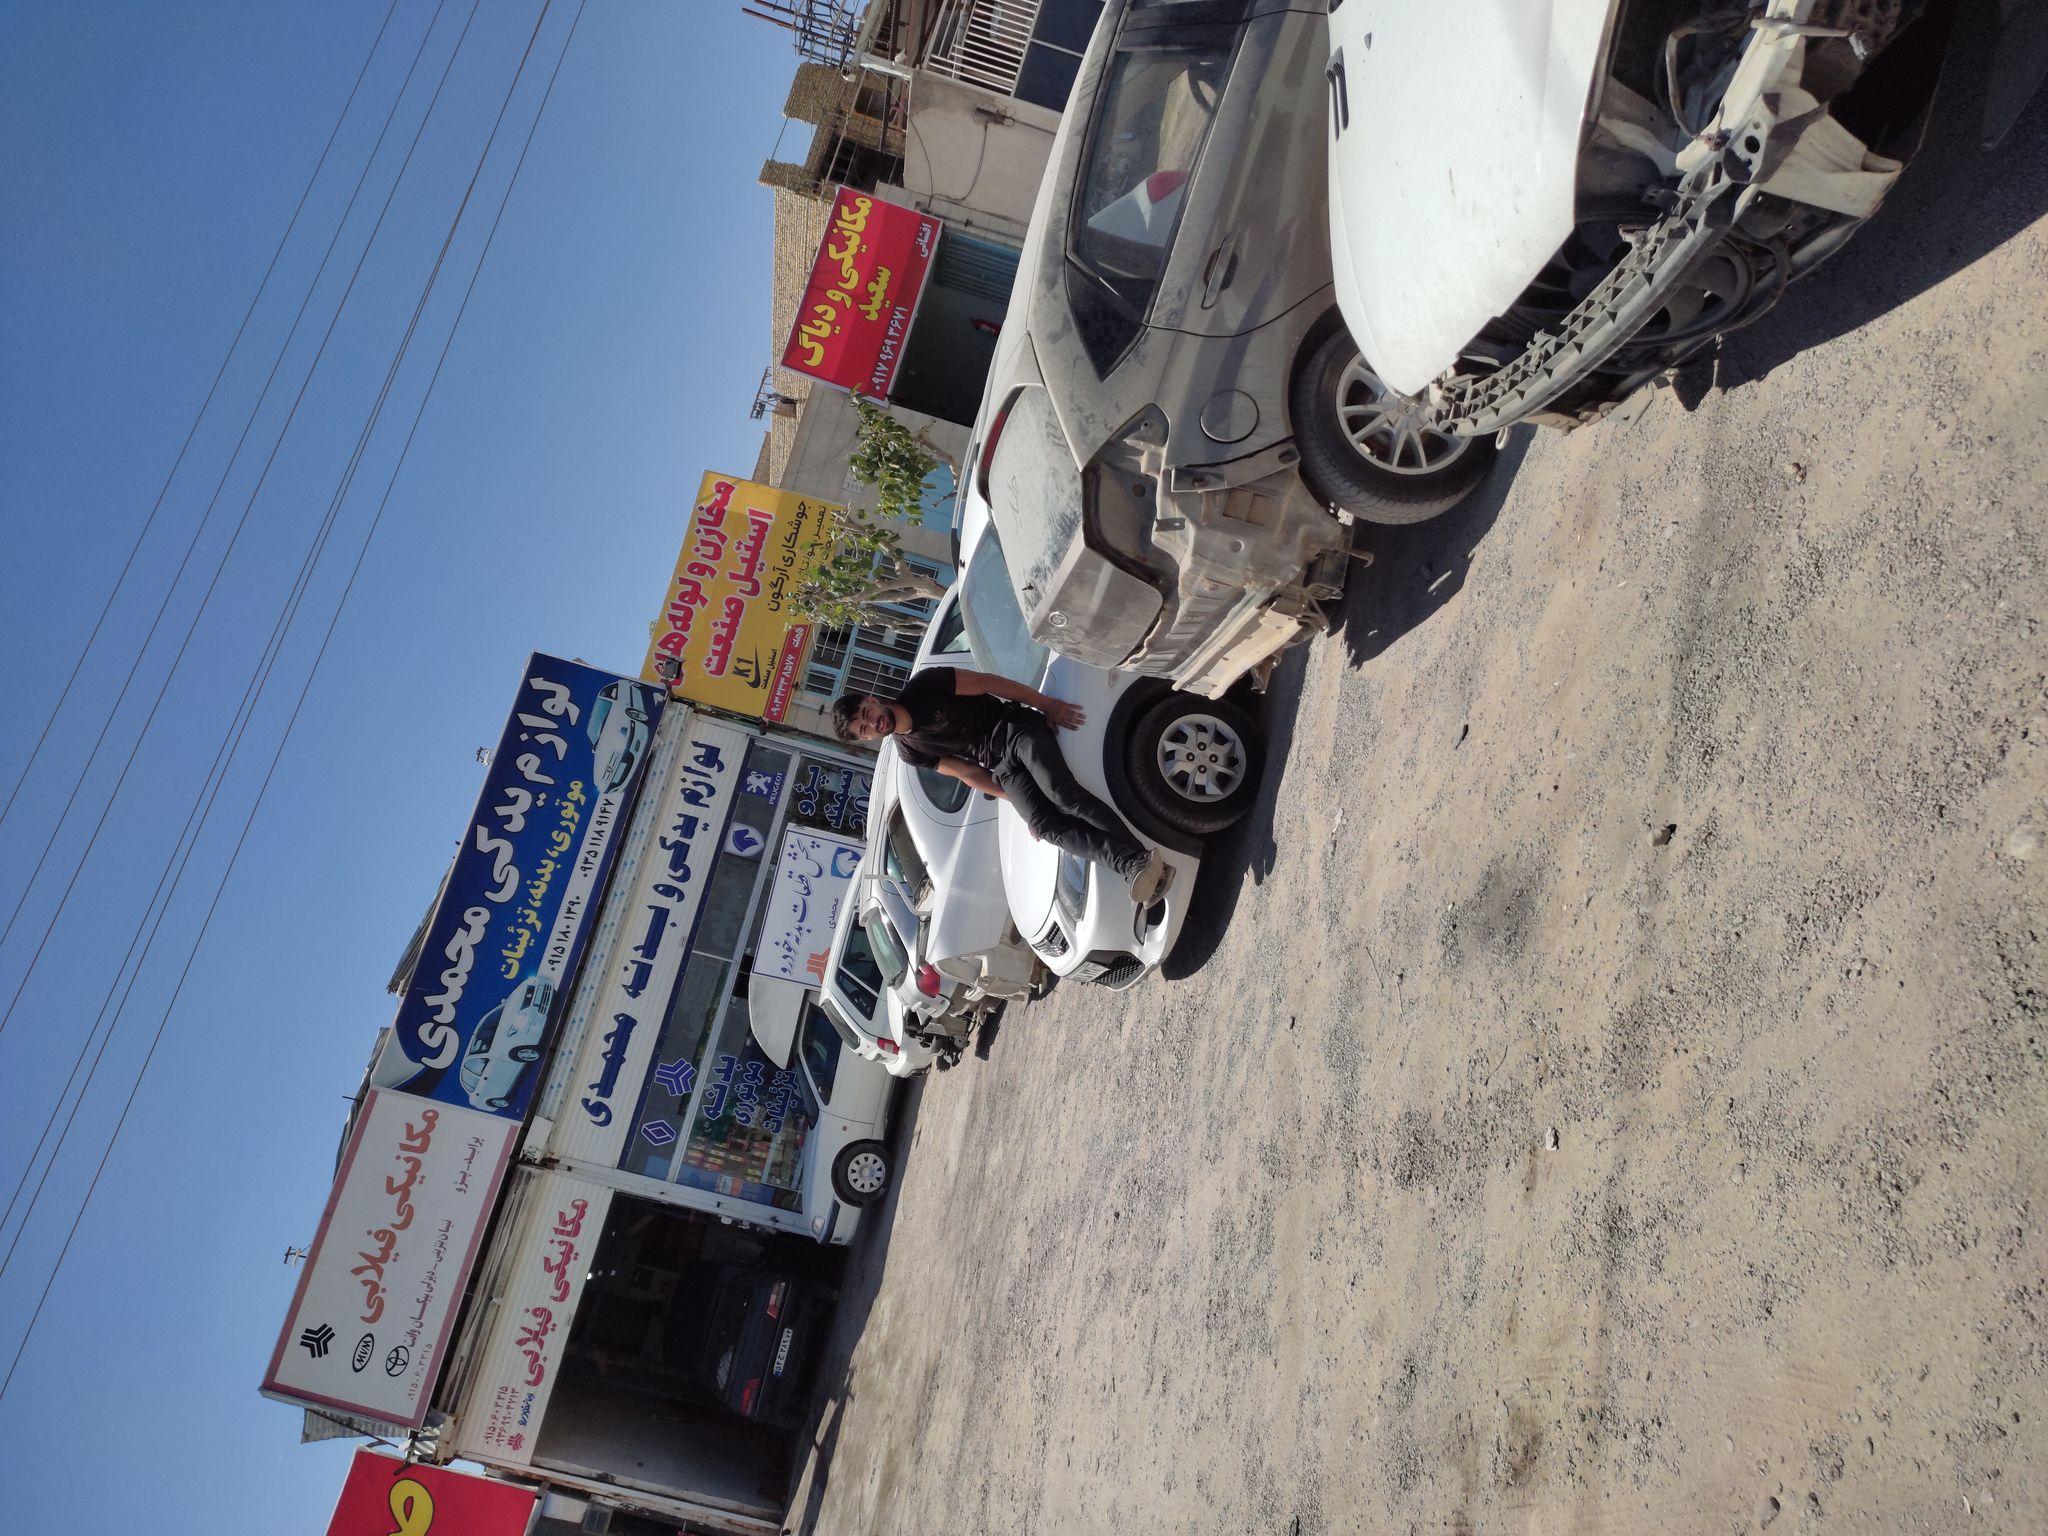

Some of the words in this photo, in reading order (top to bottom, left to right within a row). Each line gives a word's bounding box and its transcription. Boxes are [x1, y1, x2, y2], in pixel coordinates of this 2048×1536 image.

[828, 197, 872, 289] مکانیکی
[826, 289, 853, 309] و
[858, 266, 891, 321] سعید
[798, 304, 841, 367] دیاگ
[693, 481, 735, 561] مخازن
[782, 501, 812, 567] جوشکاری
[687, 562, 717, 577] و
[728, 508, 773, 597] استیل
[767, 566, 789, 612] آرگون
[704, 596, 744, 676] صنعت
[766, 649, 778, 669] استیل
[732, 658, 753, 677] K1
[761, 669, 775, 689] صنعت
[516, 677, 581, 784] لوازم
[680, 740, 724, 808] لوازم
[769, 772, 783, 805] PEUGEOT
[793, 765, 830, 816] پژو
[824, 769, 854, 828] سمند
[476, 786, 546, 903] یدکی
[580, 850, 598, 878] ۰۹۳۵
[589, 830, 605, 846] ۱۱۸
[659, 813, 709, 882] یدکی
[787, 839, 823, 878] پخش
[652, 882, 684, 902] و
[788, 874, 811, 922] قطعات
[825, 898, 839, 929] محمدی
[500, 908, 543, 980] تزئینات
[548, 946, 565, 971] ۰۹۱۵
[557, 925, 570, 942] ۱۸۰
[564, 896, 581, 920] ۱۳۹۰
[621, 905, 678, 999] بدنه
[774, 940, 794, 976] خودرو
[786, 926, 812, 945] بدنه
[417, 905, 491, 1069] محمدی
[581, 1013, 637, 1127] محمدی
[702, 1056, 742, 1120] بدنه
[734, 1062, 764, 1125] موتوری
[763, 1071, 798, 1134] تزئینات
[386, 1109, 440, 1231] مکانیکی
[451, 1171, 471, 1194] پژو
[350, 1228, 399, 1324] فیلابی
[544, 1198, 589, 1302] مکانیکی
[410, 1294, 434, 1328] پیکان
[420, 1271, 436, 1292] دیزلی
[356, 1338, 372, 1366] MVM
[404, 1330, 420, 1347] وانت
[514, 1307, 557, 1387] فیلابی
